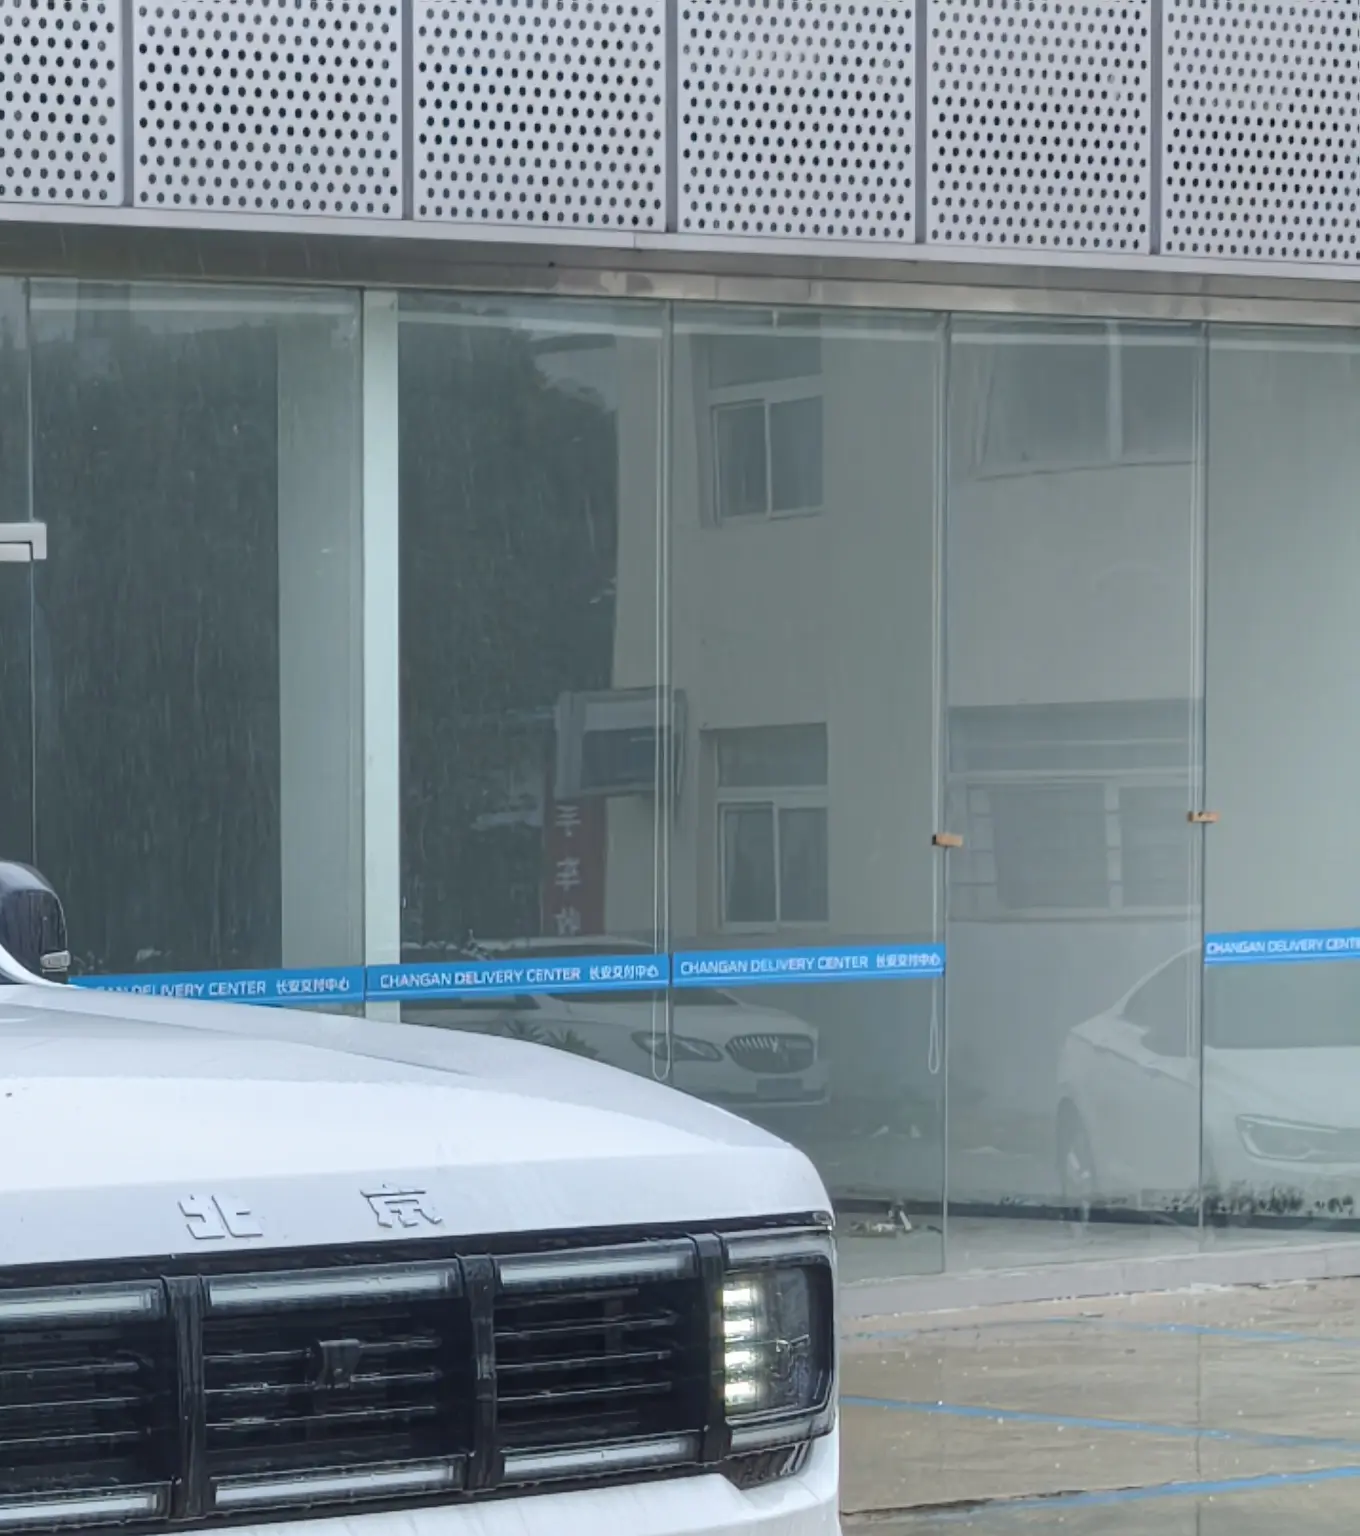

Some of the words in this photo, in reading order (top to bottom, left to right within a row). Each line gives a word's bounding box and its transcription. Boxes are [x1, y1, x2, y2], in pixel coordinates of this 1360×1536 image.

[680, 960, 748, 976] CHANGAN
[750, 957, 816, 973] DELIVERY
[817, 955, 869, 970] CENTER
[209, 980, 266, 996] CENTER
[380, 973, 451, 989] CHANGAN
[454, 969, 524, 985] DELIVERY
[526, 968, 581, 982] CENTER
